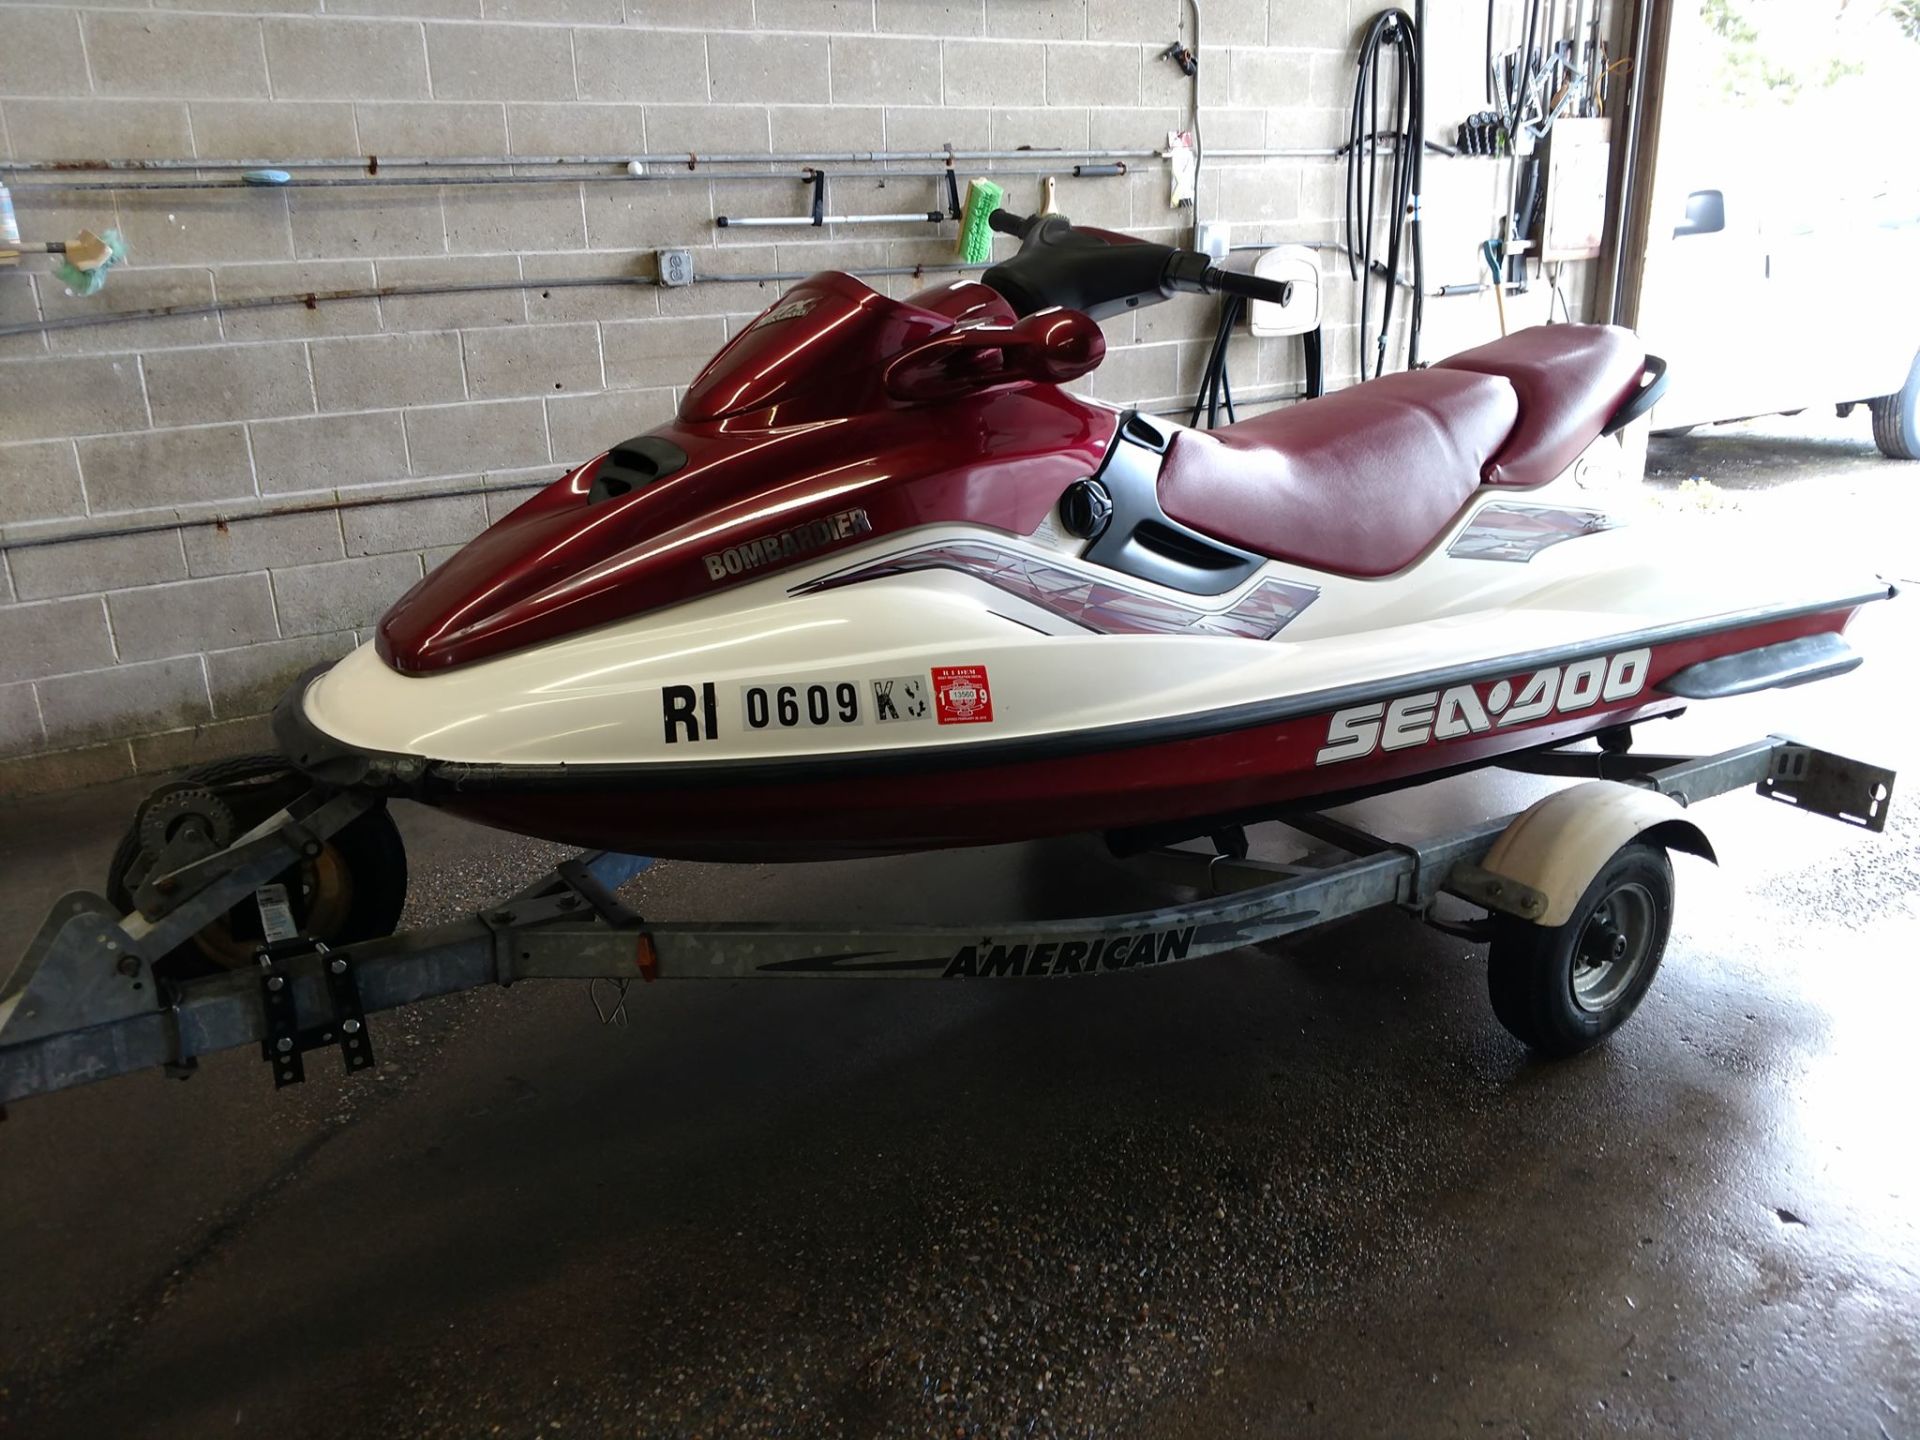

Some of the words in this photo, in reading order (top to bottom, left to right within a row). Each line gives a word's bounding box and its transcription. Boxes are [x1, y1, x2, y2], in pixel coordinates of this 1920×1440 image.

[702, 507, 873, 581] BOMBARDIER
[662, 682, 718, 744] RI
[746, 682, 858, 728] 0609
[942, 926, 1195, 978] AMERICAN
